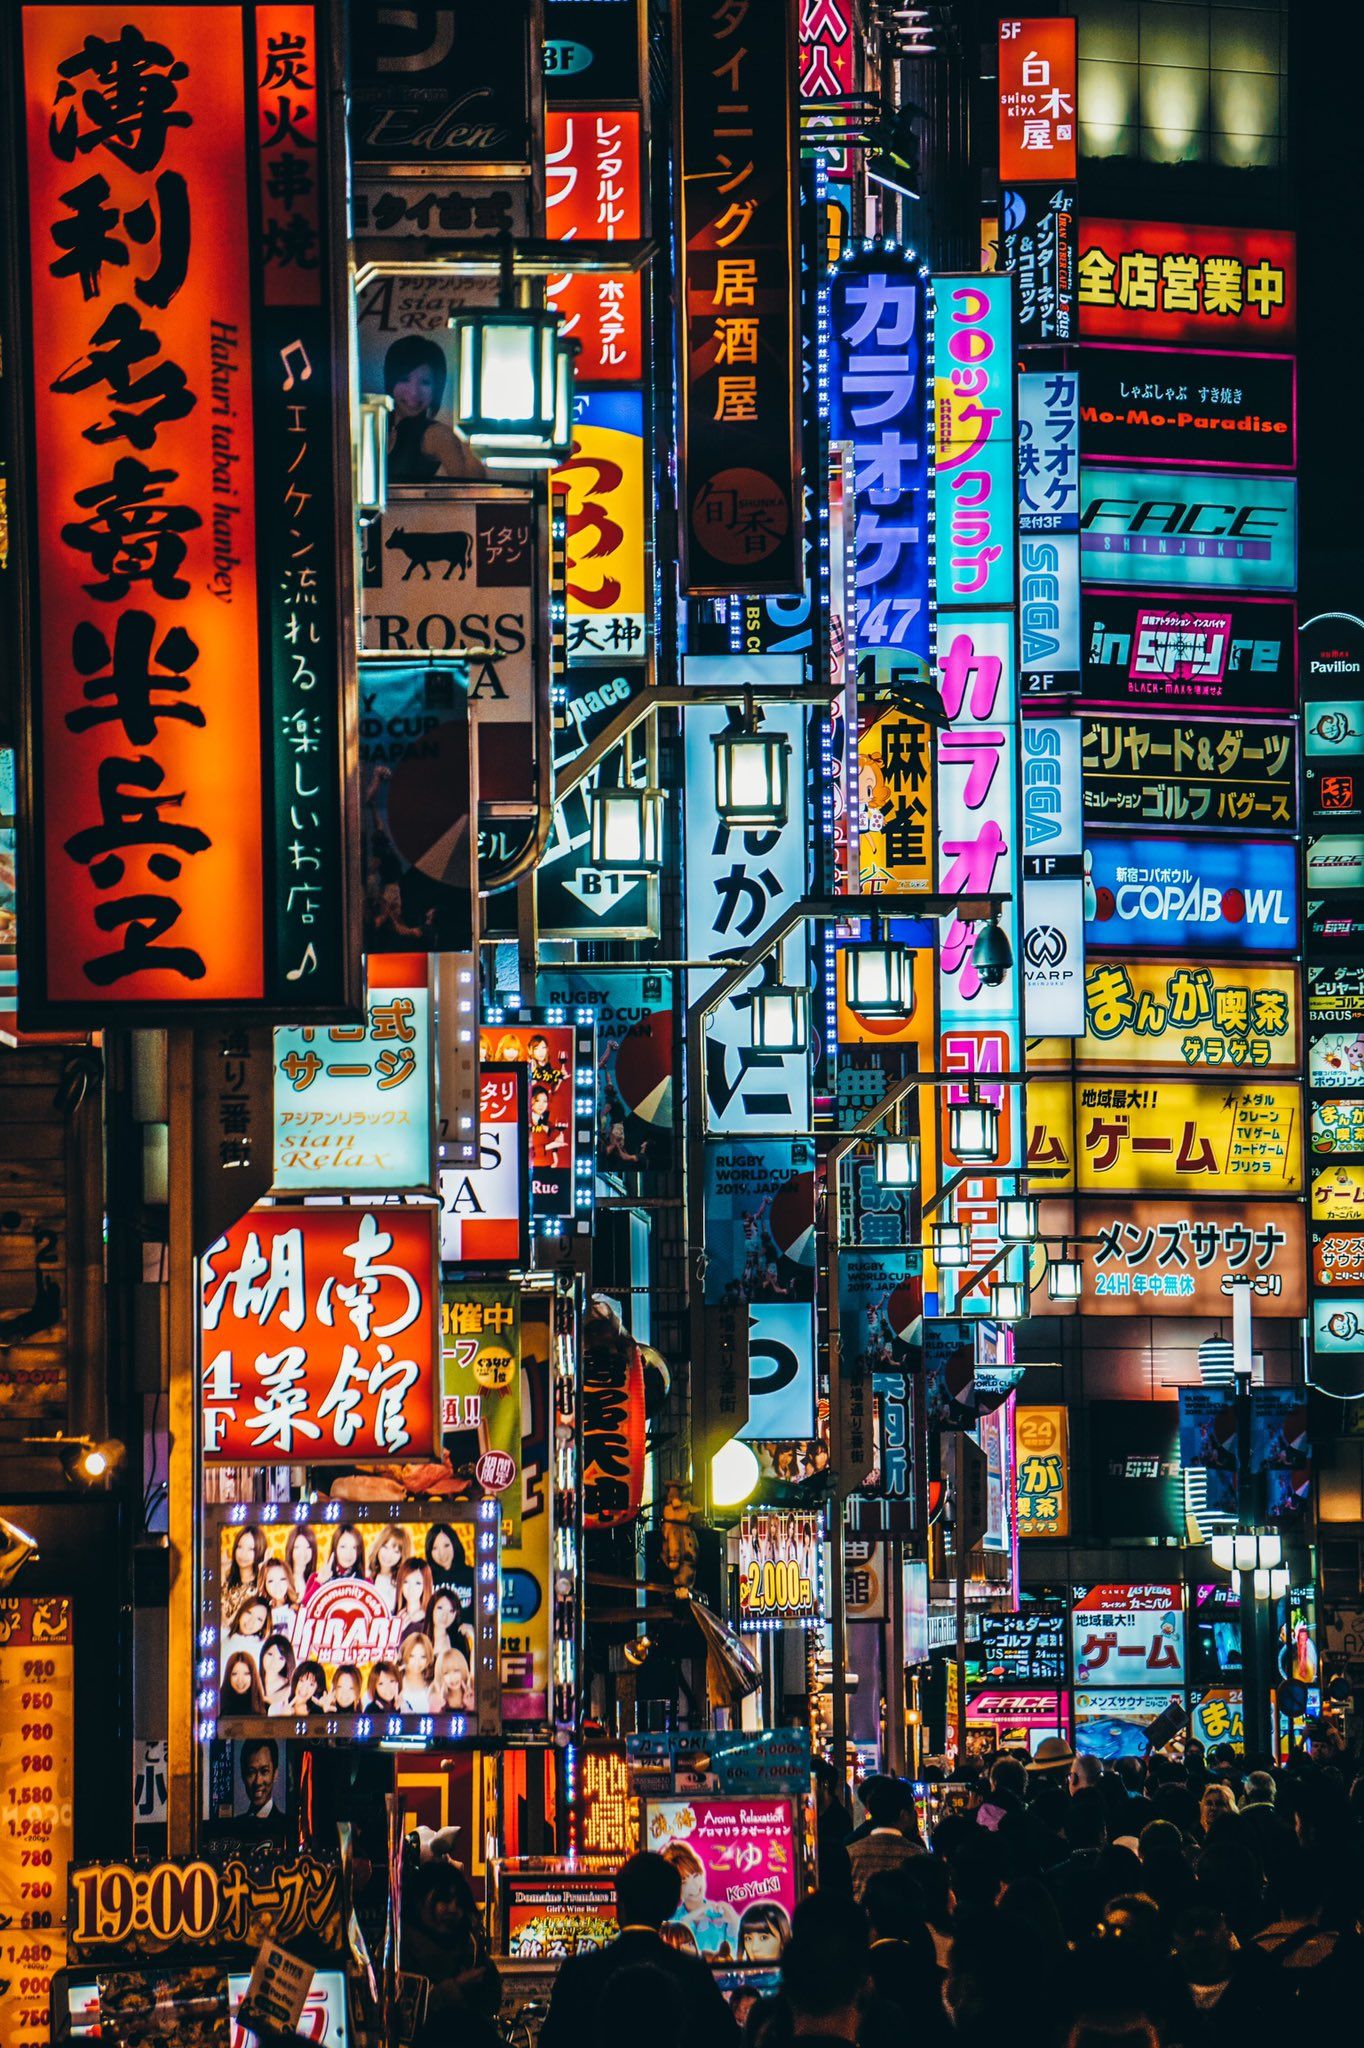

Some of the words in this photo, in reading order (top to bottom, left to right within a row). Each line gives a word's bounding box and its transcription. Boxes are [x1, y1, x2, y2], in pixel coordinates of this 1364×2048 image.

[1001, 22, 1021, 40] 5F
[1020, 50, 1075, 150] 白木屋
[1049, 189, 1074, 212] 4F
[1036, 212, 1055, 338] インターネット
[1078, 248, 1286, 318] 全店営業中
[598, 280, 627, 366] ホステル
[209, 320, 238, 417] Hakuri
[1119, 381, 1188, 401] しゃぶしゃぶ
[1197, 385, 1243, 404] すき焼き
[842, 273, 919, 588] カラオケ
[1080, 406, 1288, 433] Mo-Mo-Paradise
[211, 421, 237, 498] tabai
[1080, 498, 1288, 539] FACE
[207, 504, 237, 604] hanbey
[1103, 537, 1245, 557] SHINJUKU
[1021, 543, 1060, 665] SEGA
[1310, 661, 1361, 674] Pavilion
[1028, 675, 1054, 691] 2F
[881, 718, 928, 869] 麻雀
[1024, 727, 1060, 848] SEGA
[1217, 791, 1291, 822] バグース
[1031, 858, 1057, 875] 1F
[1115, 866, 1193, 884] 新宿コパボウル
[581, 873, 620, 894] B1
[1085, 967, 1290, 1041] まんが喫茶
[1309, 1010, 1352, 1021] BAGUS
[1181, 1038, 1272, 1067] ゲラゲラ
[1081, 1088, 1158, 1109] 地域最大!!
[1238, 1110, 1280, 1123] クレーン
[1085, 1114, 1221, 1175] ゲーム
[716, 1155, 764, 1168] RUGBY
[716, 1168, 767, 1182] WORLD
[1093, 1219, 1287, 1270] メンズサウナ
[1095, 1273, 1129, 1295] 24H
[1133, 1273, 1195, 1296] 年中無休
[1021, 1421, 1051, 1438] 24
[1076, 1613, 1136, 1627] 地域最大!!
[1081, 1631, 1182, 1670] ゲーム
[1089, 1695, 1146, 1707] メンズサウナ
[21, 1723, 53, 1741] 980
[21, 1755, 53, 1773] 980
[703, 1809, 737, 1825] Aroma
[739, 1807, 786, 1825] Relaxation
[21, 1849, 52, 1867] 780
[21, 1882, 52, 1899] 780
[70, 1861, 218, 1944] 19:00
[216, 1854, 342, 1942] オープン
